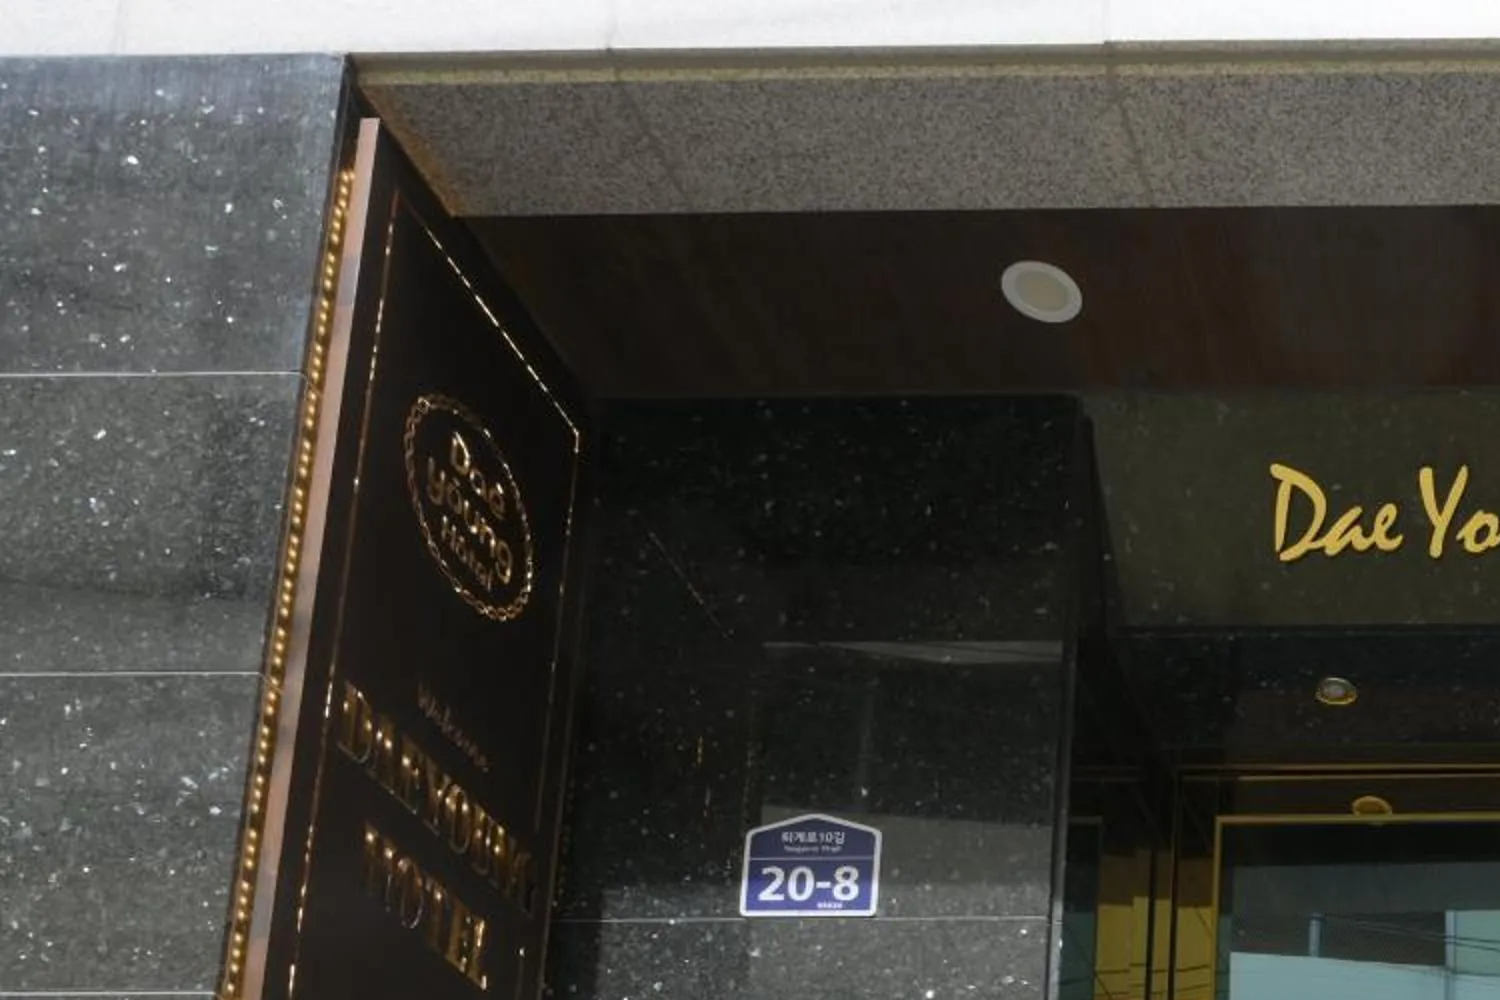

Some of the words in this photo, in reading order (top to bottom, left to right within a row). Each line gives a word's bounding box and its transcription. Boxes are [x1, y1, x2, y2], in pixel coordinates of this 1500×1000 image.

[451, 431, 505, 520] Dae
[1270, 463, 1403, 561] Dae
[757, 865, 860, 902] 20-8
